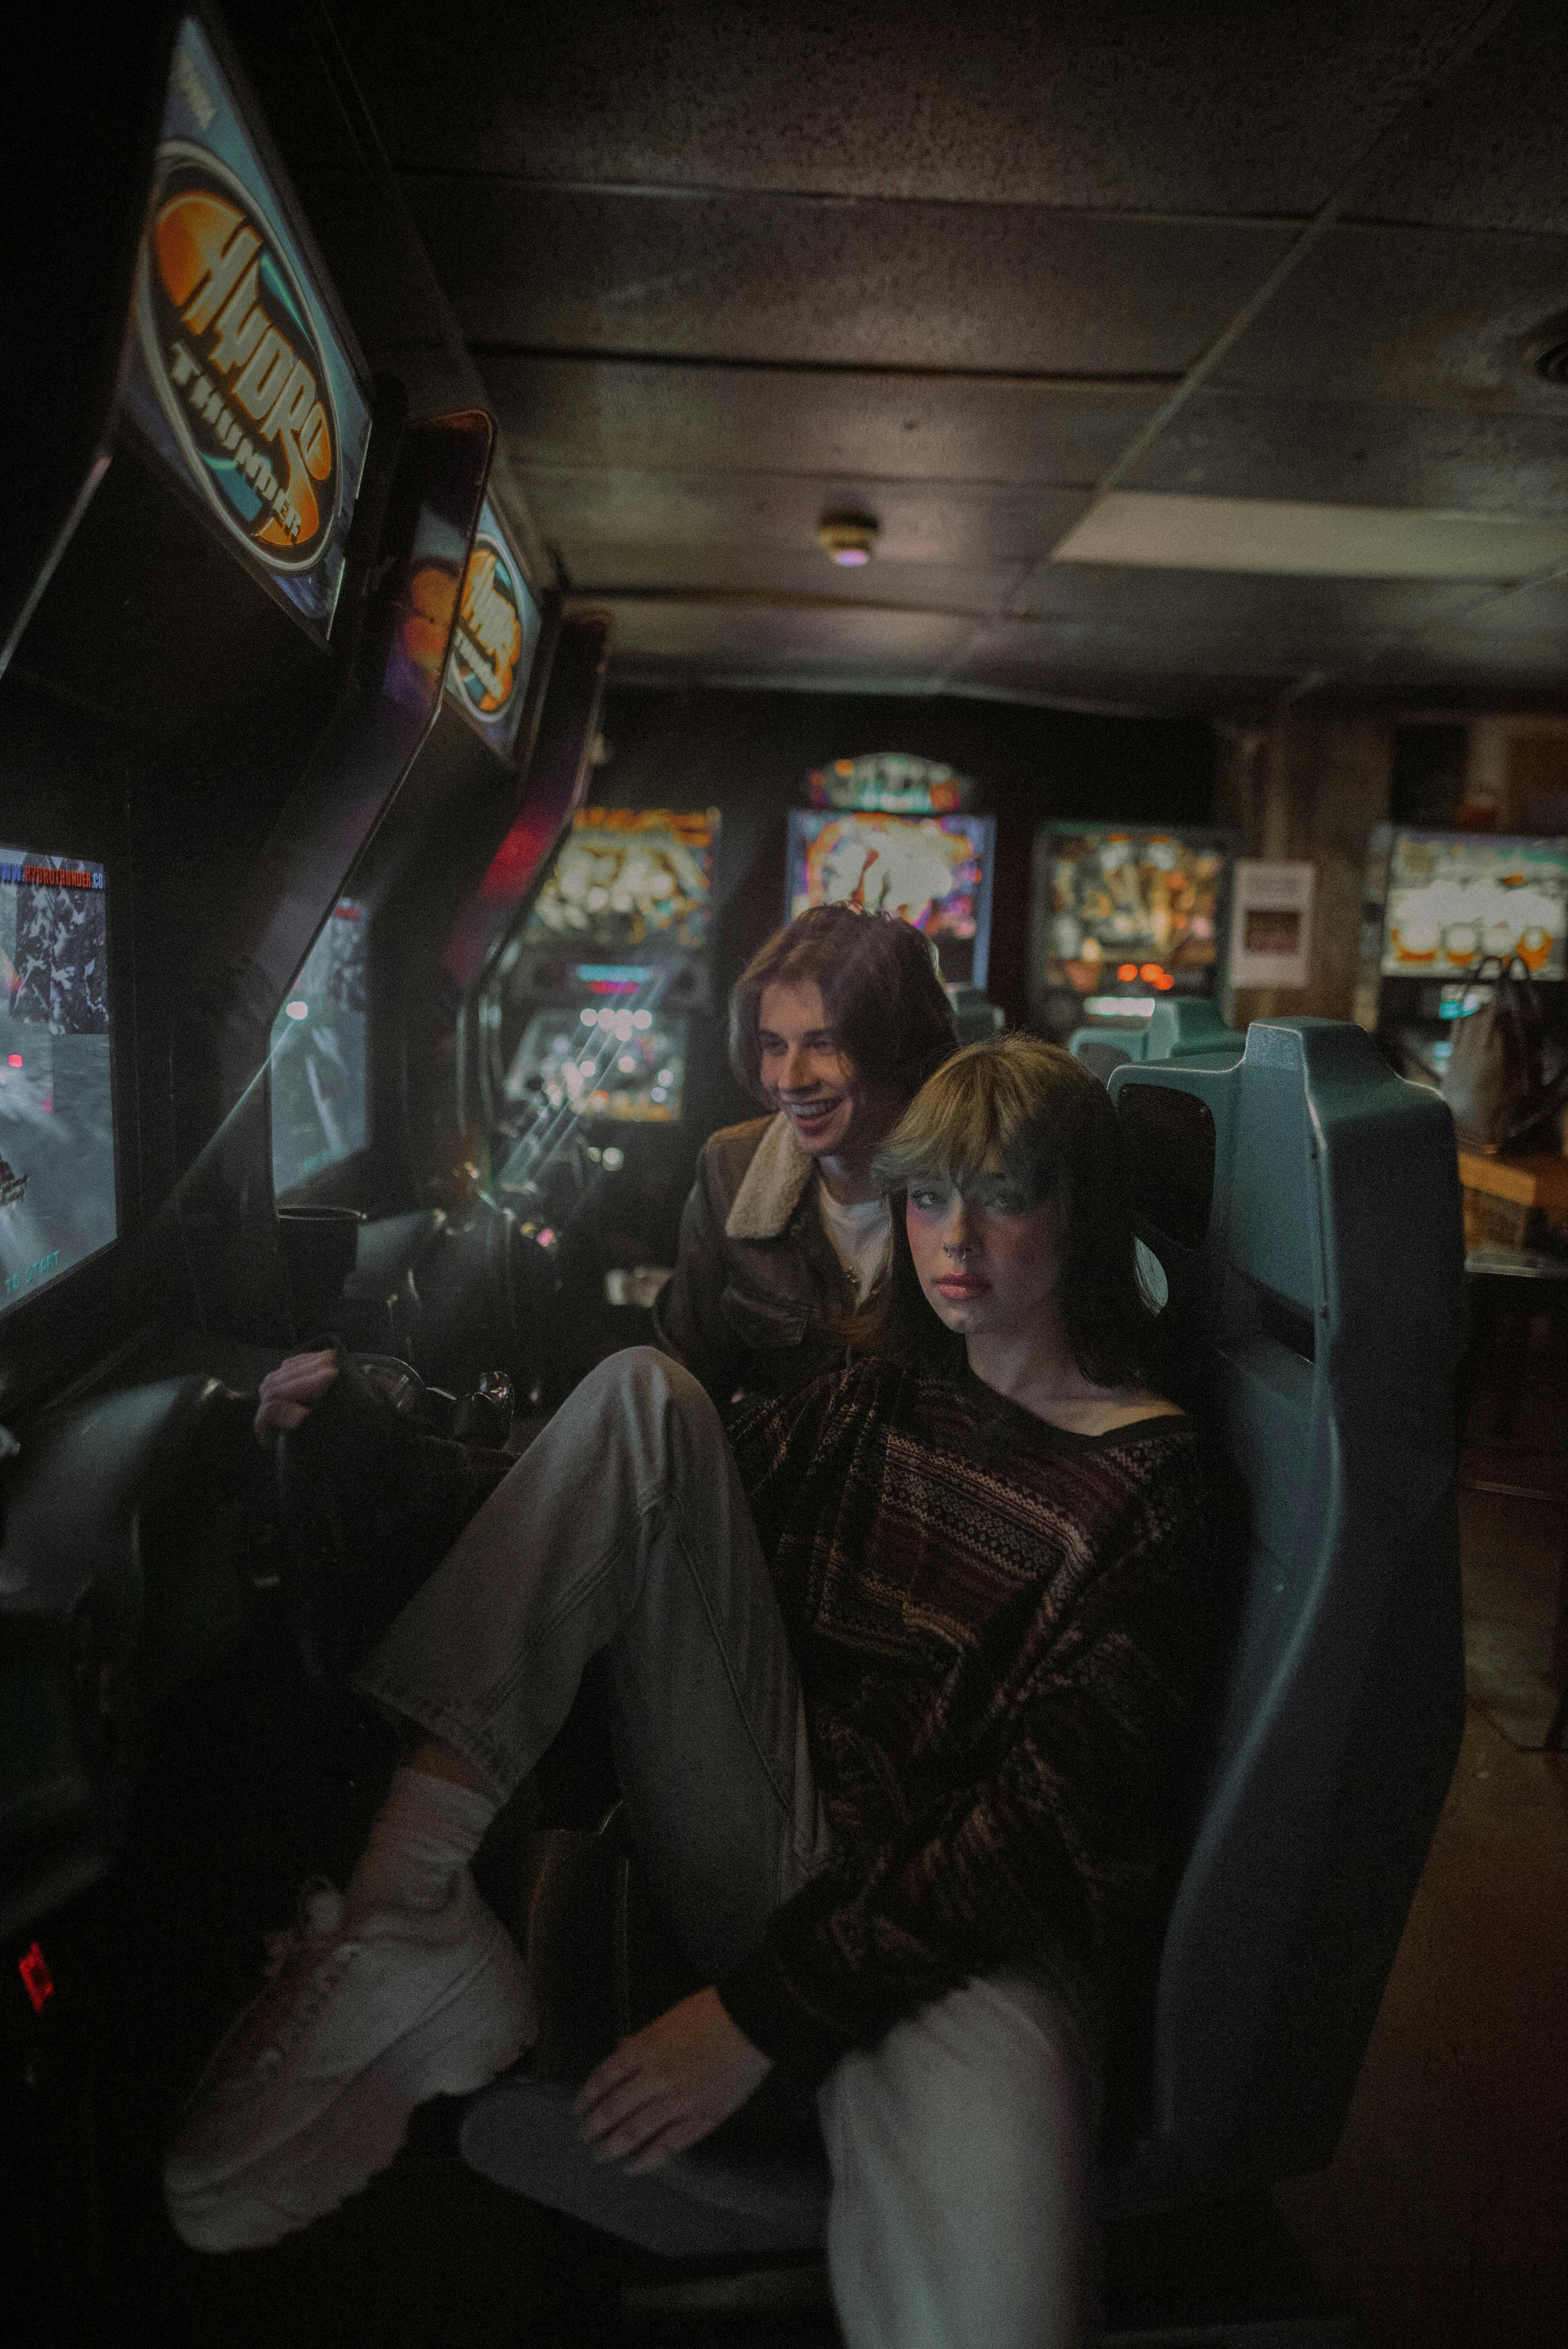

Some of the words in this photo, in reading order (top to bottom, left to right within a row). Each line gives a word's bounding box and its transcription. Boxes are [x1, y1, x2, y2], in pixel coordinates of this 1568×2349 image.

[158, 192, 331, 482] HYDRO
[170, 339, 302, 542] THUNDER
[5, 1273, 20, 1294] TO
[25, 1250, 60, 1283] START
